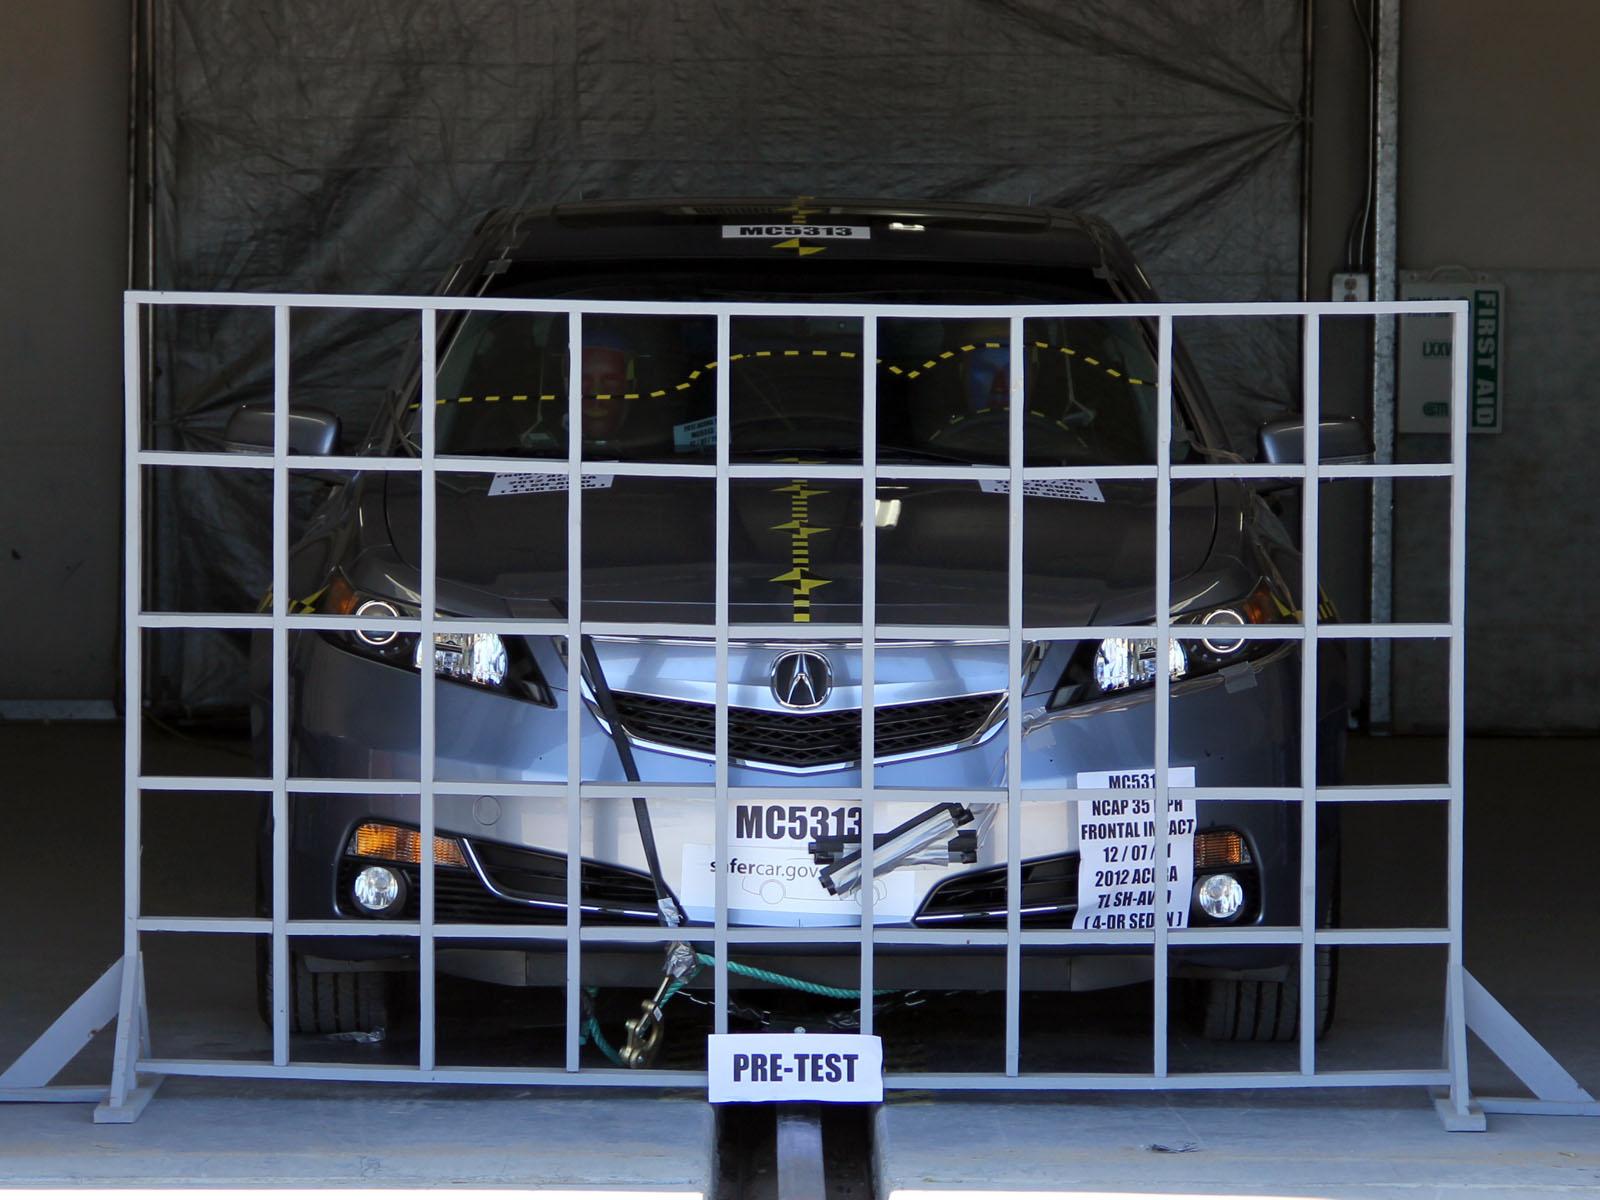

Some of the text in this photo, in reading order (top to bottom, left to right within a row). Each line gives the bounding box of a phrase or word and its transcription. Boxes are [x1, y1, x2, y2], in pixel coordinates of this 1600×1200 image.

[739, 226, 853, 237] MC5313
[1476, 292, 1497, 426] FIRST AID
[1108, 774, 1156, 789] MC531
[1092, 799, 1183, 816] NCAP 35 PH
[736, 805, 862, 840] MC5313
[1081, 819, 1194, 840] FRONTAL IACT
[1103, 846, 1118, 862] 12
[1131, 845, 1147, 861] 07
[709, 857, 821, 881] sfercar.gov
[1095, 865, 1178, 887] 2012 ACA
[1098, 894, 1111, 909] TL
[1092, 914, 1126, 930] 4-DR
[1129, 911, 1174, 929] SEDN
[733, 1053, 859, 1083] PRE-TEST
